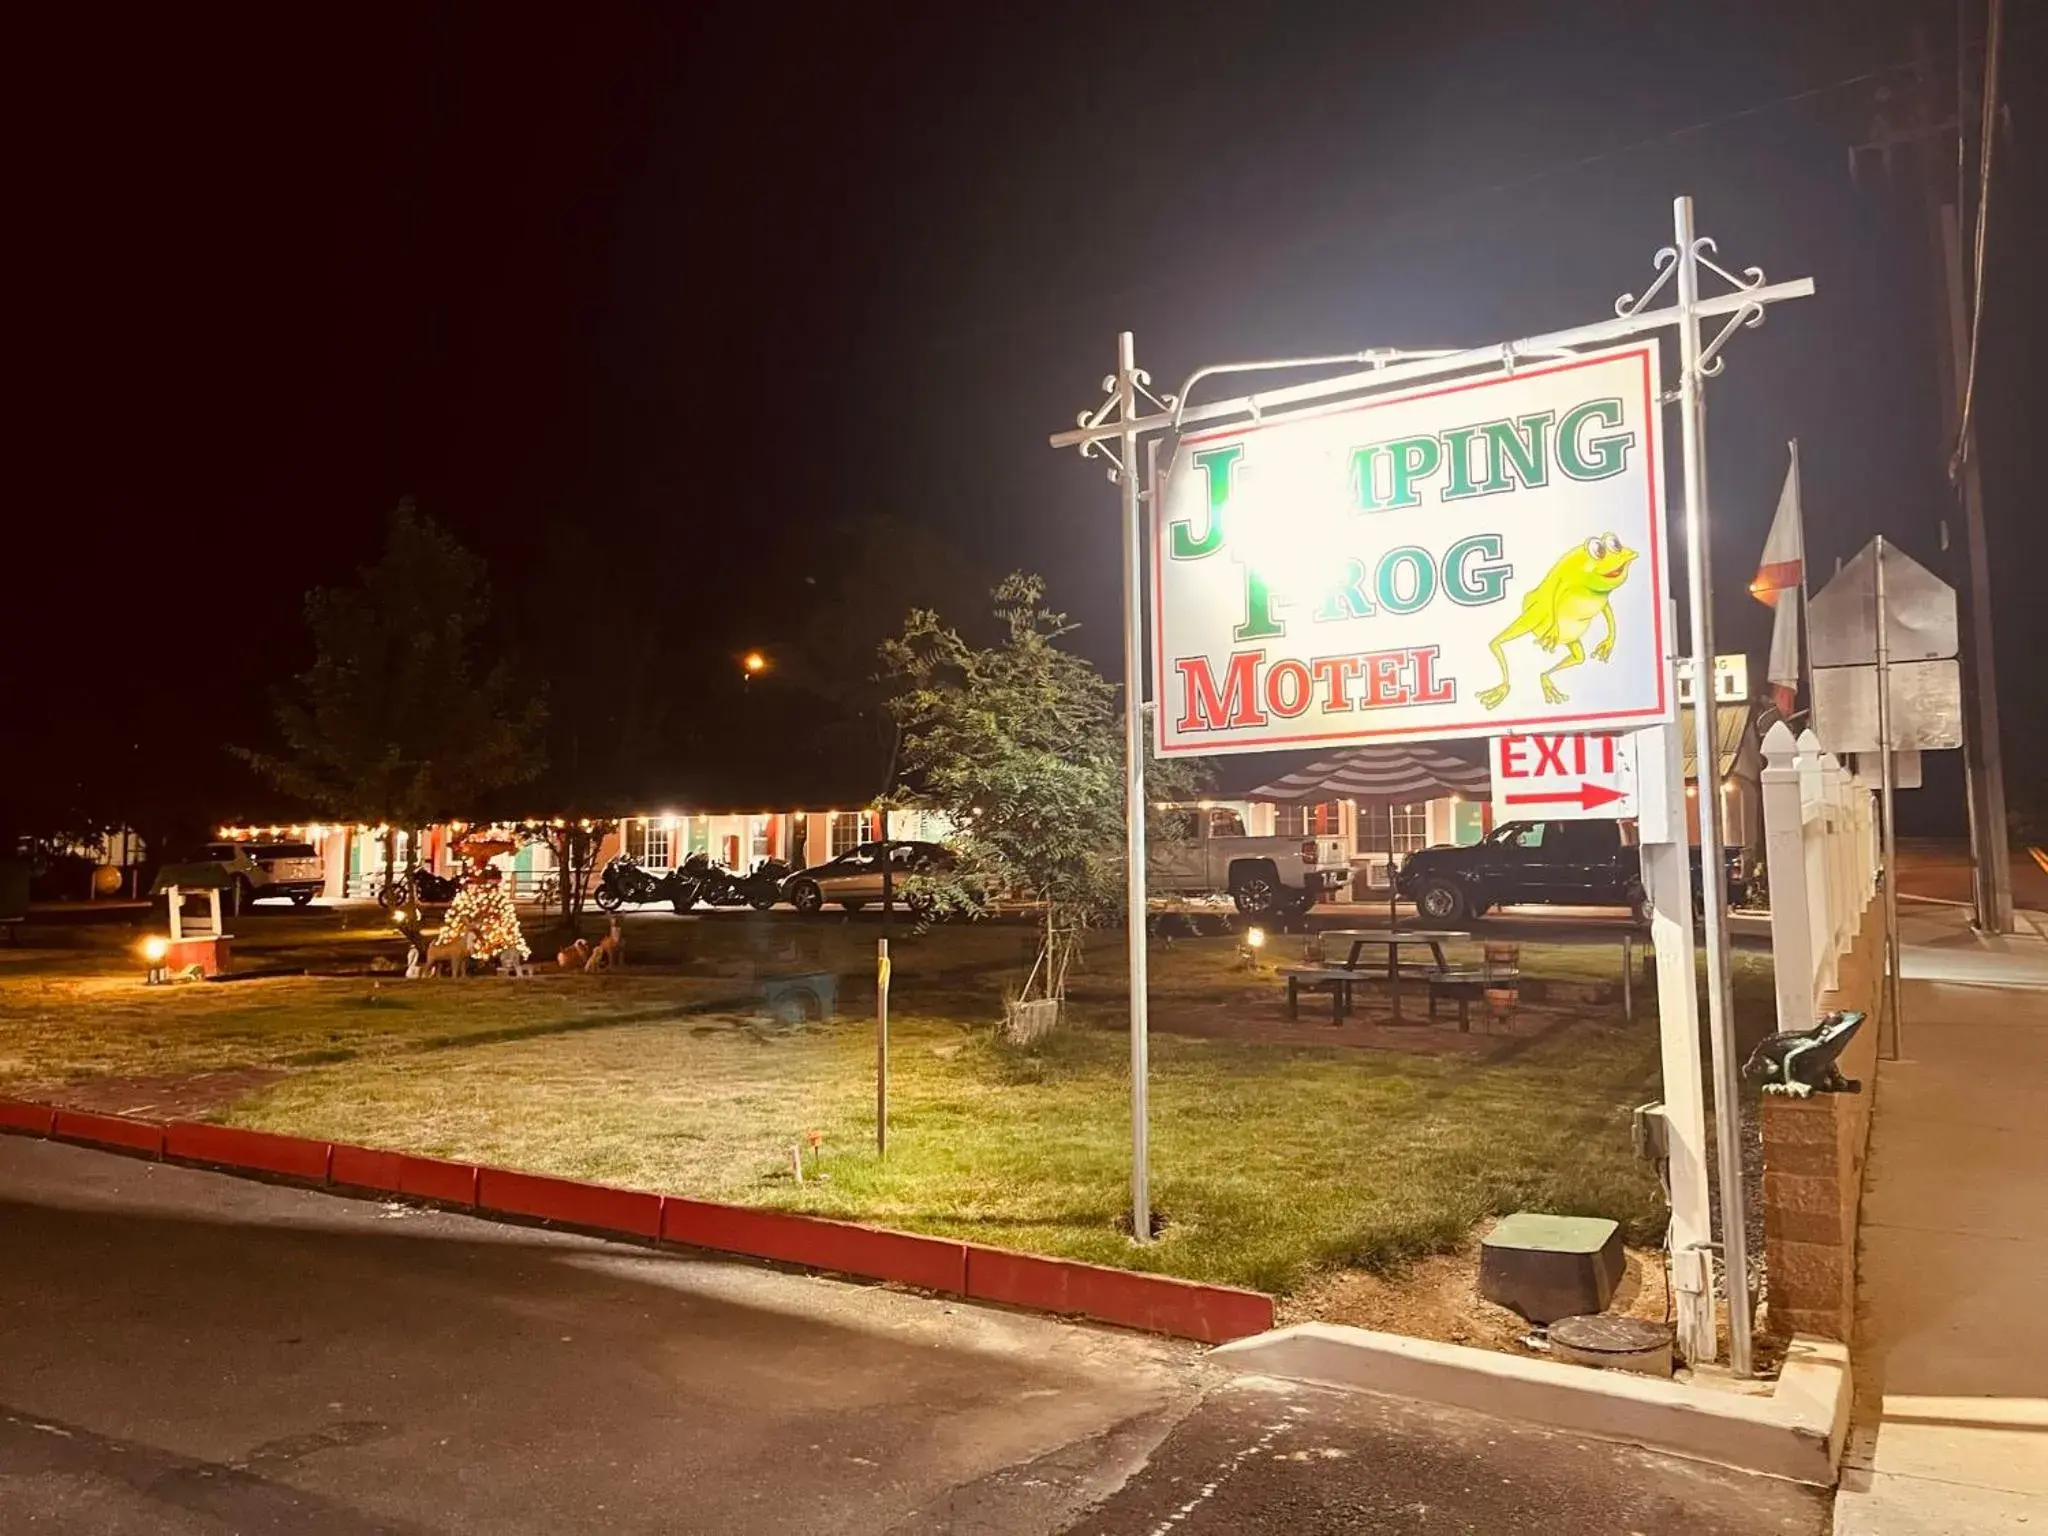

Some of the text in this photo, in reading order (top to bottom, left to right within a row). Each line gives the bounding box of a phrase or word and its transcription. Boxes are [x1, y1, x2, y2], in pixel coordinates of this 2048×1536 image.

[1169, 397, 1635, 560] JPING
[1176, 644, 1457, 734] MOTEL
[1500, 731, 1624, 778] EXIT
